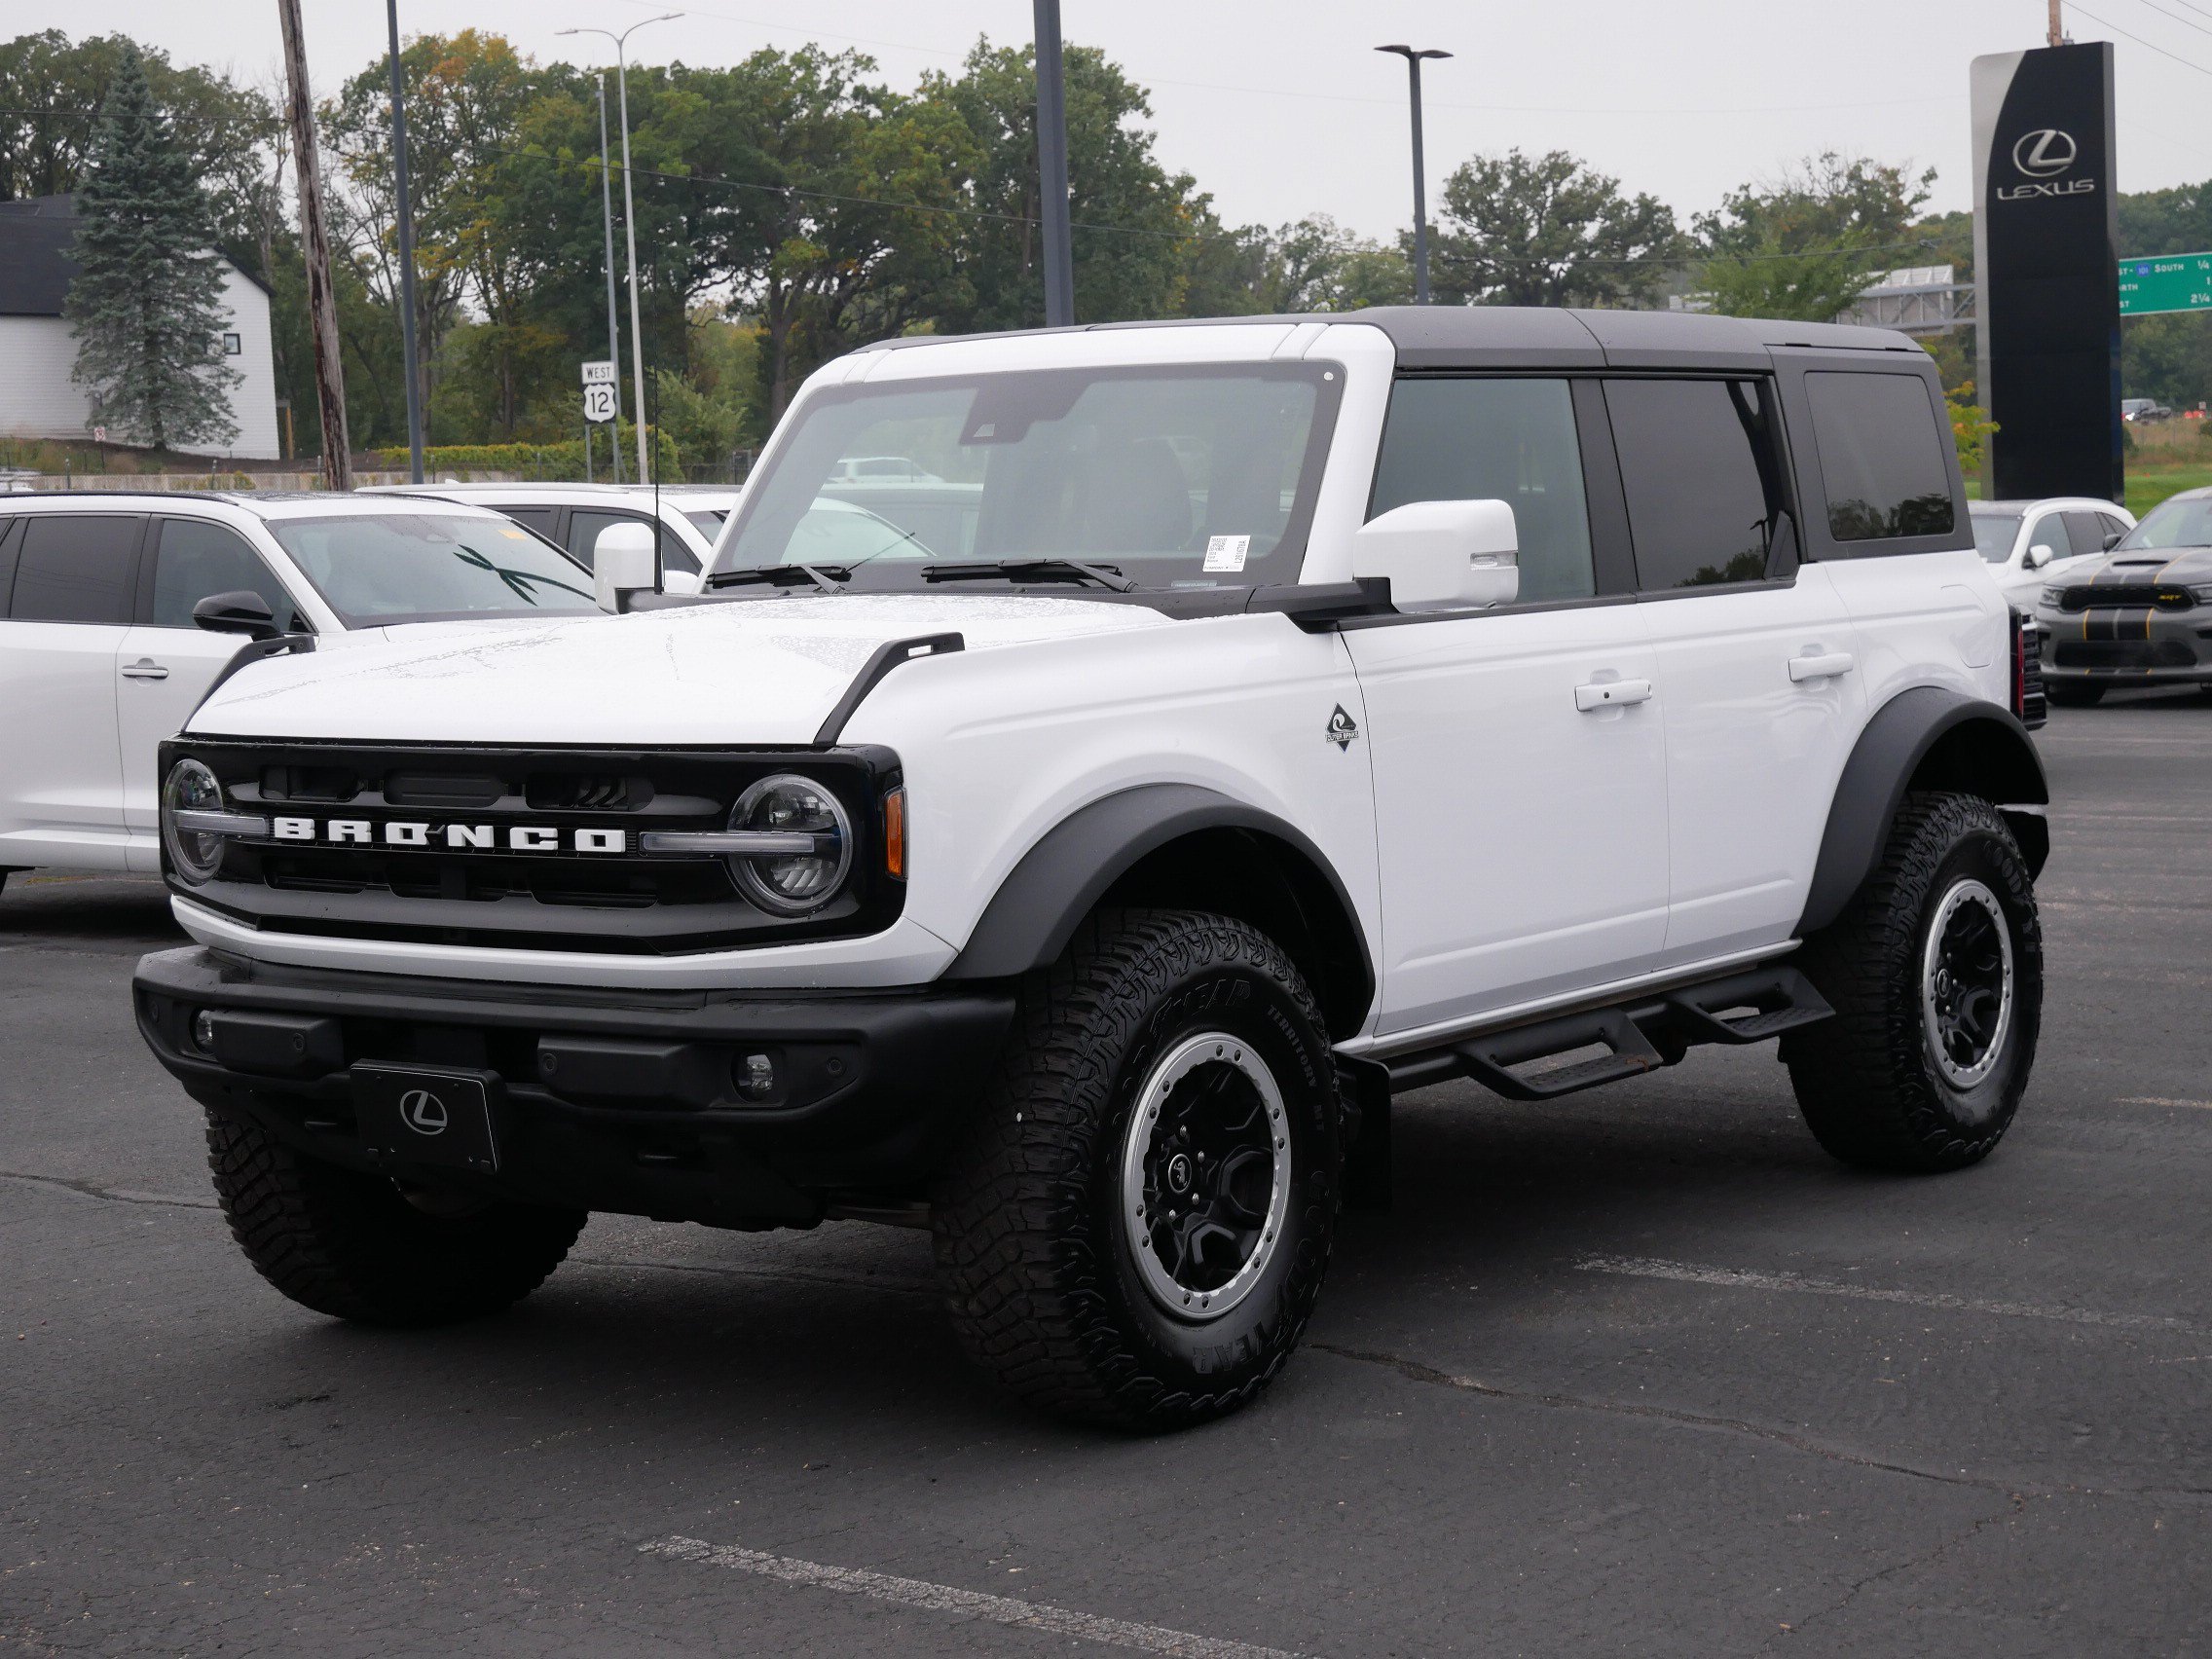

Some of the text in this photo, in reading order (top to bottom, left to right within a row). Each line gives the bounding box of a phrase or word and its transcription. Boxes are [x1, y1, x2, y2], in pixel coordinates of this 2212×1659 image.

[1997, 179, 2095, 201] LEXUS
[586, 367, 610, 378] WEST
[590, 391, 609, 413] 12
[275, 817, 626, 853] BRONCO
[1268, 1004, 1317, 1088] TERRITORY
